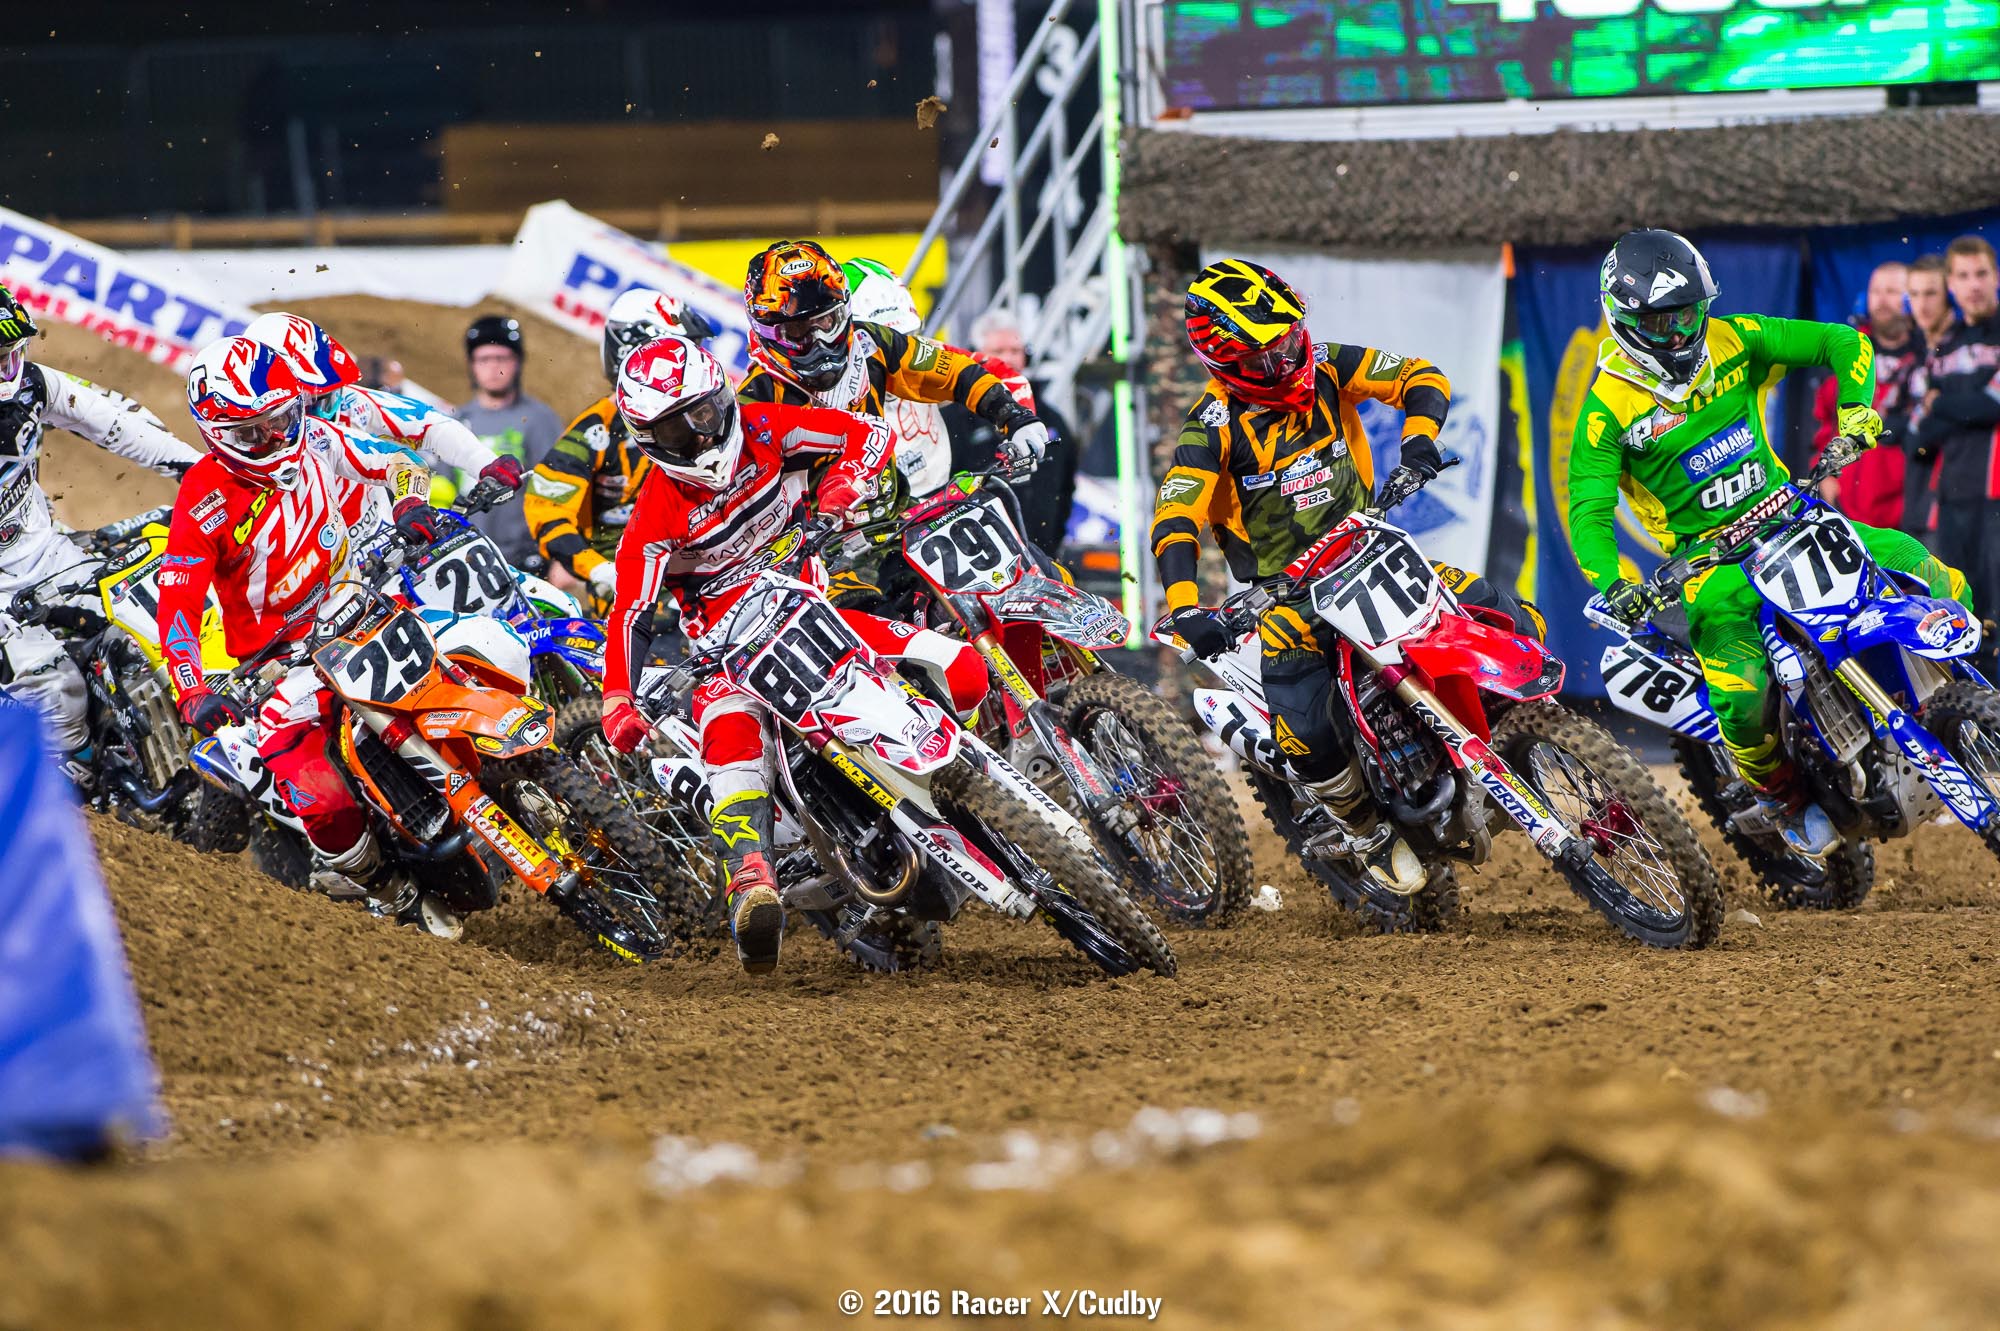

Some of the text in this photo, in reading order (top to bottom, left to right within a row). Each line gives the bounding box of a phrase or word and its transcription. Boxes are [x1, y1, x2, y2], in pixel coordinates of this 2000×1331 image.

[0, 222, 250, 340] PART
[781, 260, 812, 275] Arai
[849, 355, 864, 396] ATLAS
[1702, 427, 1754, 462] YAMAHA
[1281, 472, 1315, 496] LUCAS
[1298, 490, 1330, 510] 3BR
[1701, 461, 1763, 509] dph
[348, 500, 380, 539] OYOTA
[921, 503, 1031, 590] 291
[1348, 550, 1376, 574] MONSTER
[1760, 518, 1866, 611] 778
[268, 548, 321, 608] KTM
[435, 544, 515, 614] 28
[1334, 546, 1434, 647] 713
[755, 611, 789, 647] MONSTER
[1000, 601, 1038, 613] FHK
[1601, 616, 1627, 633] DUNLOP
[346, 606, 436, 705] 29
[525, 626, 552, 642] YOTA
[749, 602, 861, 722] 800
[1601, 644, 1688, 714] 778
[1203, 695, 1218, 712] AMA
[658, 763, 674, 777] AMA
[831, 753, 899, 811] RACE TEC
[1481, 771, 1544, 834] VERTEX
[474, 818, 537, 876] GALFER
[911, 830, 990, 894] DUNLOP
